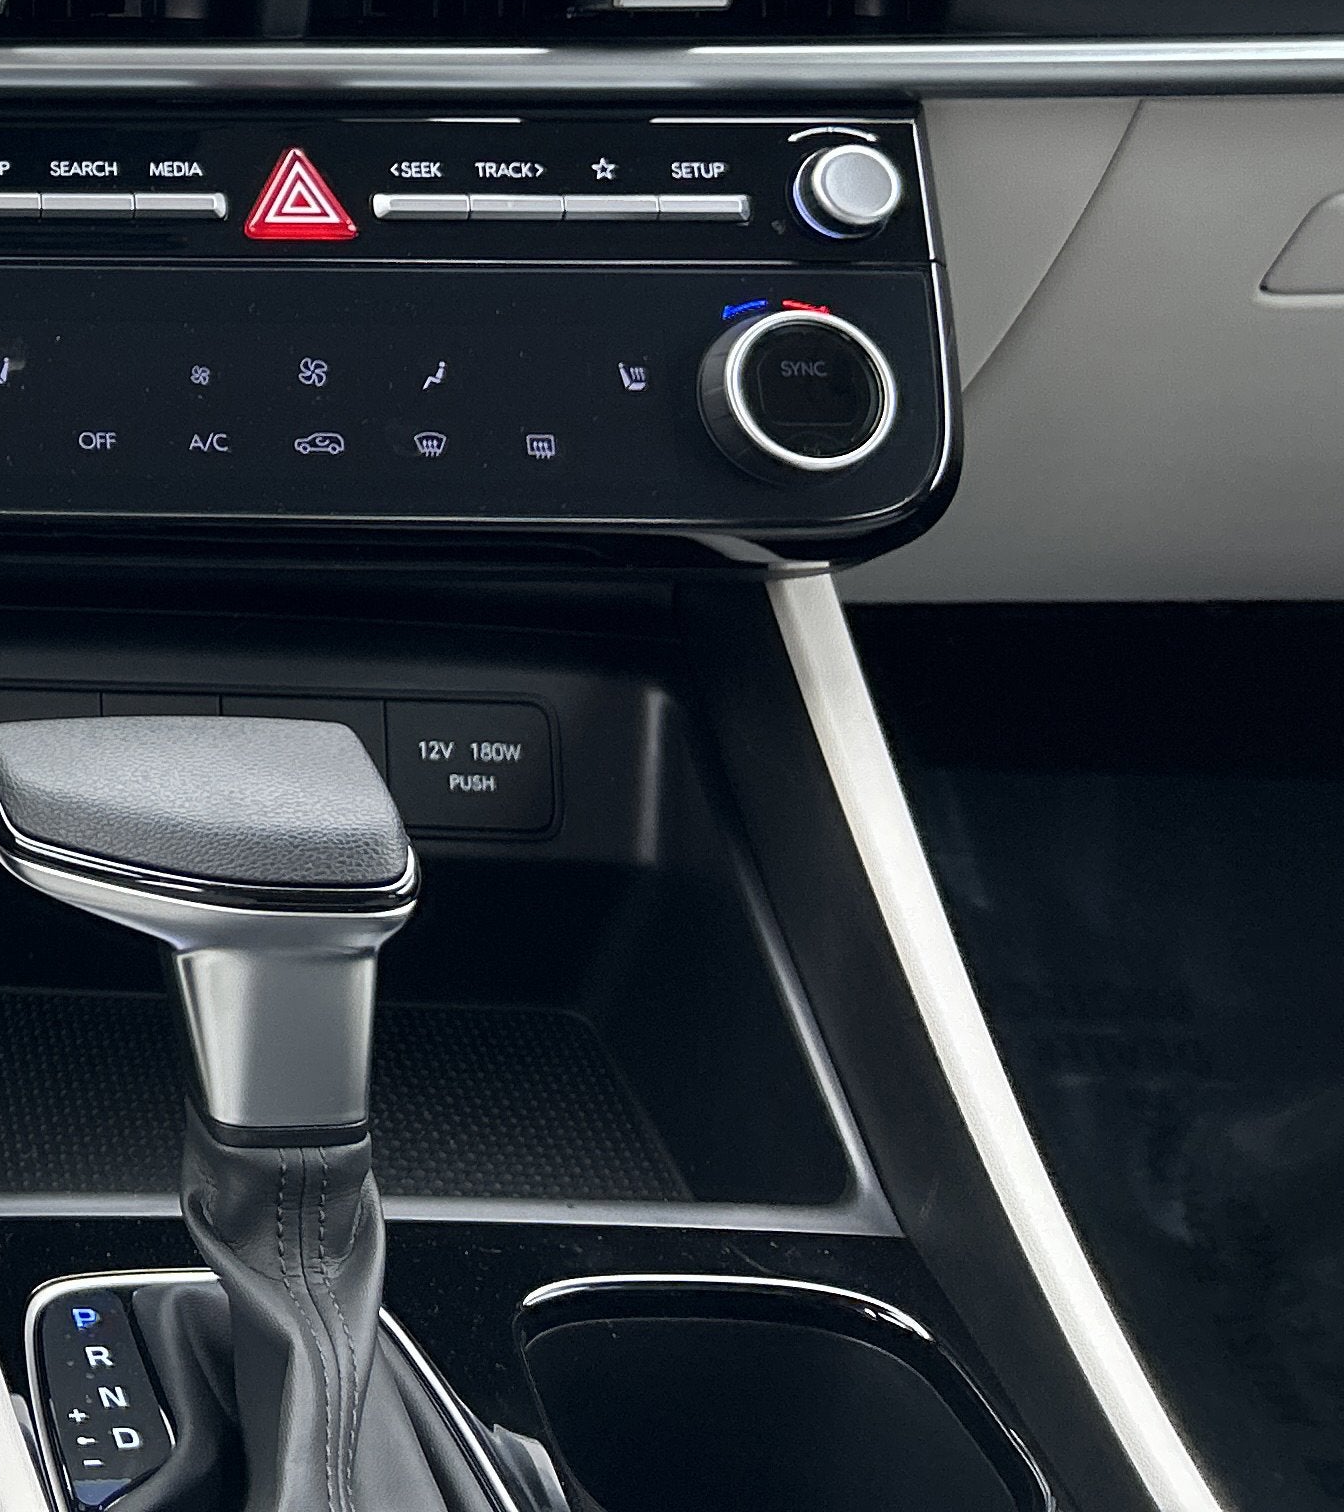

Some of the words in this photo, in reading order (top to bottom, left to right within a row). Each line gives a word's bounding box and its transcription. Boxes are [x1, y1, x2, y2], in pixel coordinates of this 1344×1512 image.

[49, 161, 118, 176] SEARCH
[149, 162, 203, 177] MEDIA
[671, 161, 725, 178] SETUP
[781, 361, 827, 378] SYNC
[78, 431, 116, 451] OFF
[189, 431, 228, 452] A/C
[418, 740, 453, 760] 12V
[470, 740, 521, 761] 180W
[449, 773, 496, 791] PUSH
[72, 1308, 98, 1331] P
[85, 1346, 113, 1367] R
[98, 1386, 128, 1408] N
[112, 1427, 141, 1449] D
